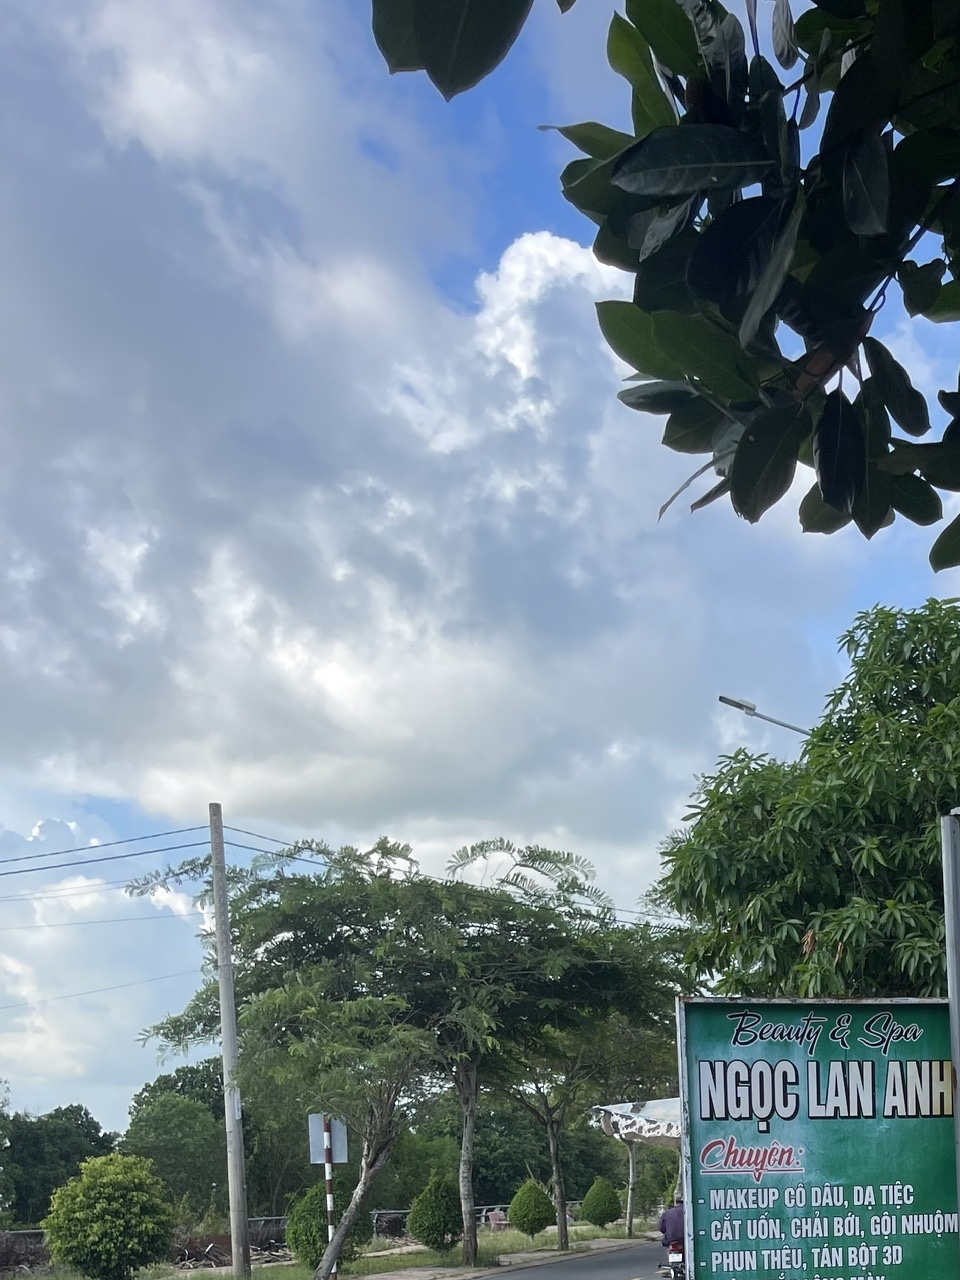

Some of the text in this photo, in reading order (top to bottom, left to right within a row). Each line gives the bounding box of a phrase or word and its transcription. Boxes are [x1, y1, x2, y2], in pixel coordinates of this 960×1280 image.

[726, 1009, 924, 1056] Beauty & Spa
[699, 1060, 955, 1133] NGỌC LAN ANH
[709, 1180, 914, 1210] MAKEUP CÔ DÂU, DẠ TIỆC
[710, 1213, 742, 1241] CẮT
[746, 1212, 785, 1241] UỐN,
[790, 1211, 829, 1239] CHẢI
[870, 1211, 897, 1239] GỘI
[901, 1210, 959, 1238] NHUỘM
[711, 1242, 903, 1272] PHUN THÊU, TÁN BỘT 3D
